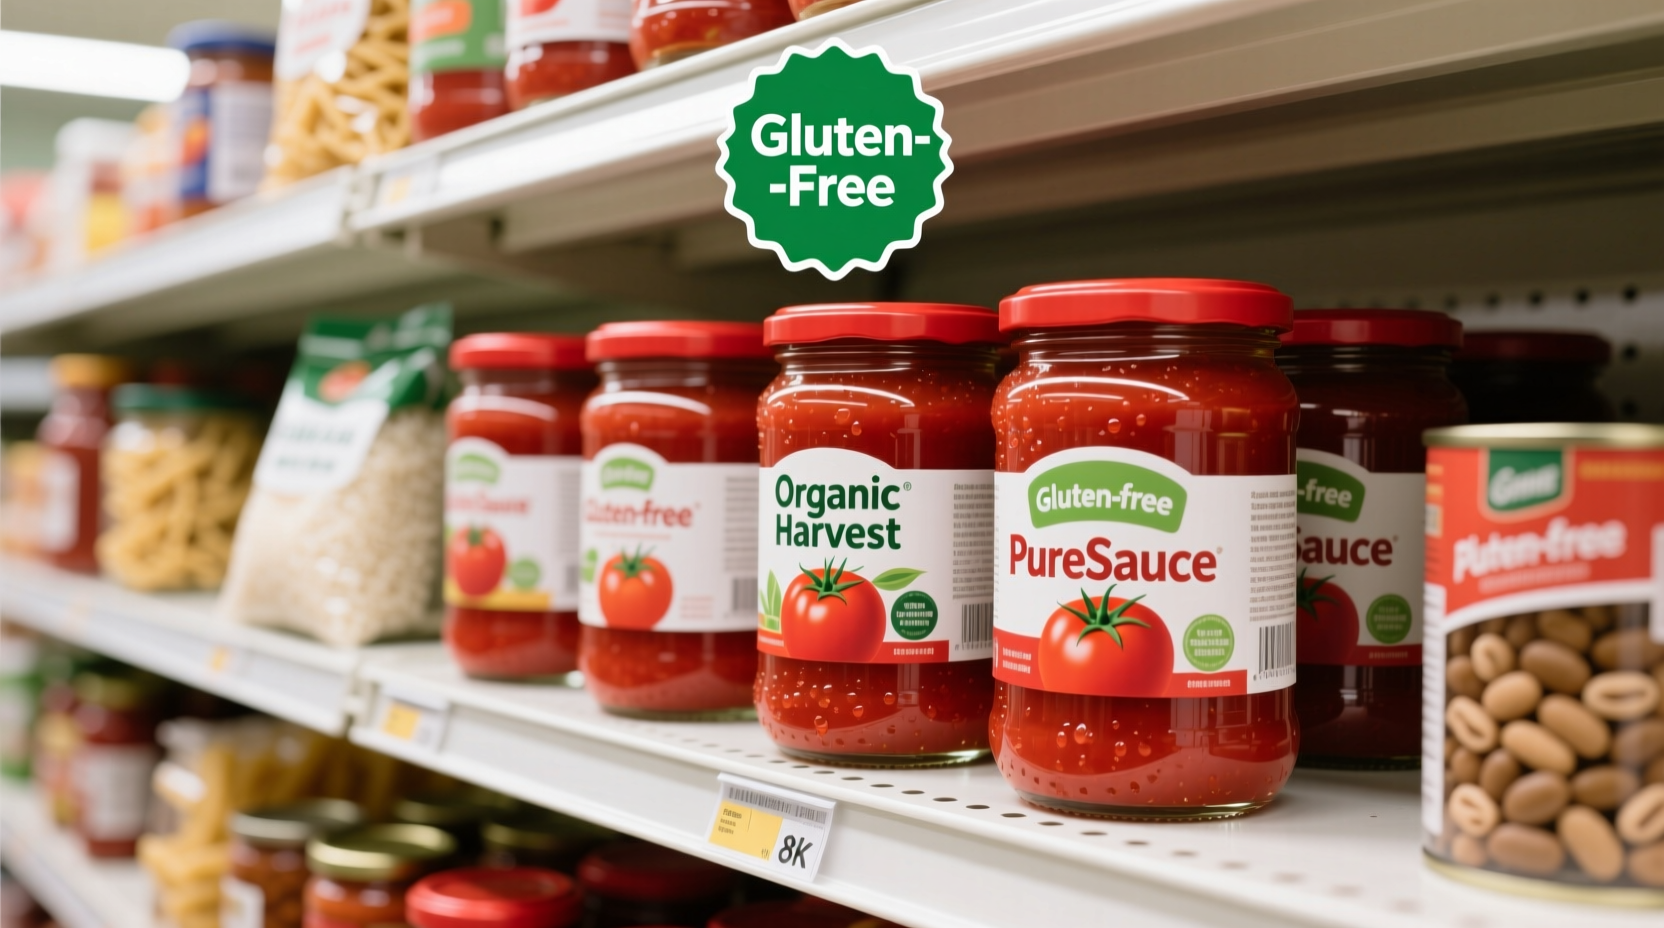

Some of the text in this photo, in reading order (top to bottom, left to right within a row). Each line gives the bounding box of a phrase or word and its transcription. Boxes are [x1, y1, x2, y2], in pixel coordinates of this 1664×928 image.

[1035, 482, 1174, 516] Gluten-free
[775, 513, 902, 550] Harvest
[1009, 534, 1218, 583] PureSauce
[778, 834, 814, 869] 8K
